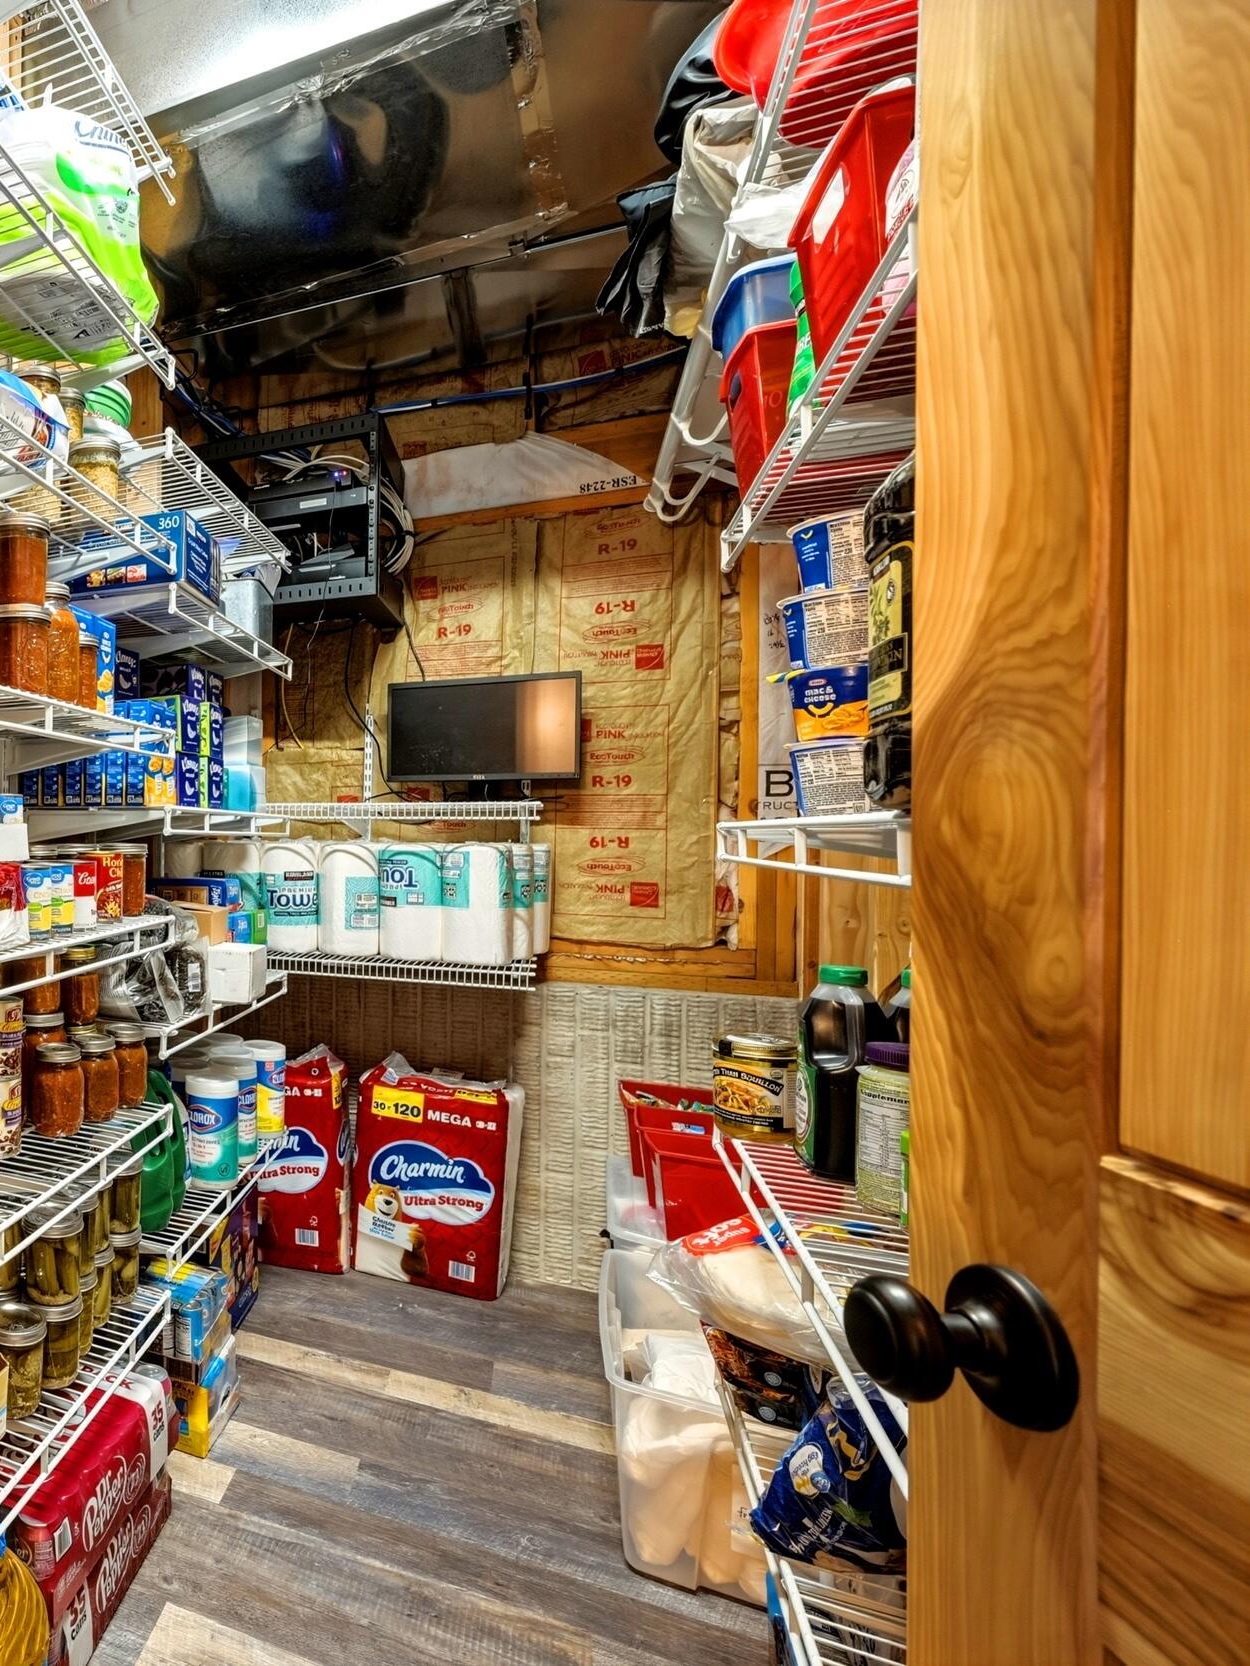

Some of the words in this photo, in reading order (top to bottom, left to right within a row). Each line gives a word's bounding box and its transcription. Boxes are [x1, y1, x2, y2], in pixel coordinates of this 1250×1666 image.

[579, 475, 638, 494] ESR-2248
[158, 515, 180, 529] 360
[598, 538, 638, 555] R-19
[441, 583, 467, 594] PINK
[595, 600, 635, 615] R-19
[438, 624, 472, 639] R-19
[601, 649, 631, 658] PINK
[596, 730, 626, 739] PINK
[590, 752, 635, 761] EcoTouch
[592, 775, 632, 788] R-19
[589, 836, 630, 849] R-19
[587, 863, 632, 871] EcoTouch
[596, 884, 625, 893] PINK
[285, 1087, 301, 1097] GA
[373, 1100, 386, 1111] 30
[393, 1102, 421, 1118] 120
[428, 1110, 471, 1128] MEGA
[279, 1165, 320, 1178] Strong
[380, 1155, 465, 1184] Charmin
[404, 1195, 436, 1207] Ultra
[438, 1196, 484, 1211] Strong
[151, 1400, 163, 1427] 35
[99, 1470, 112, 1501] Dr
[85, 1464, 126, 1552] Pepper
